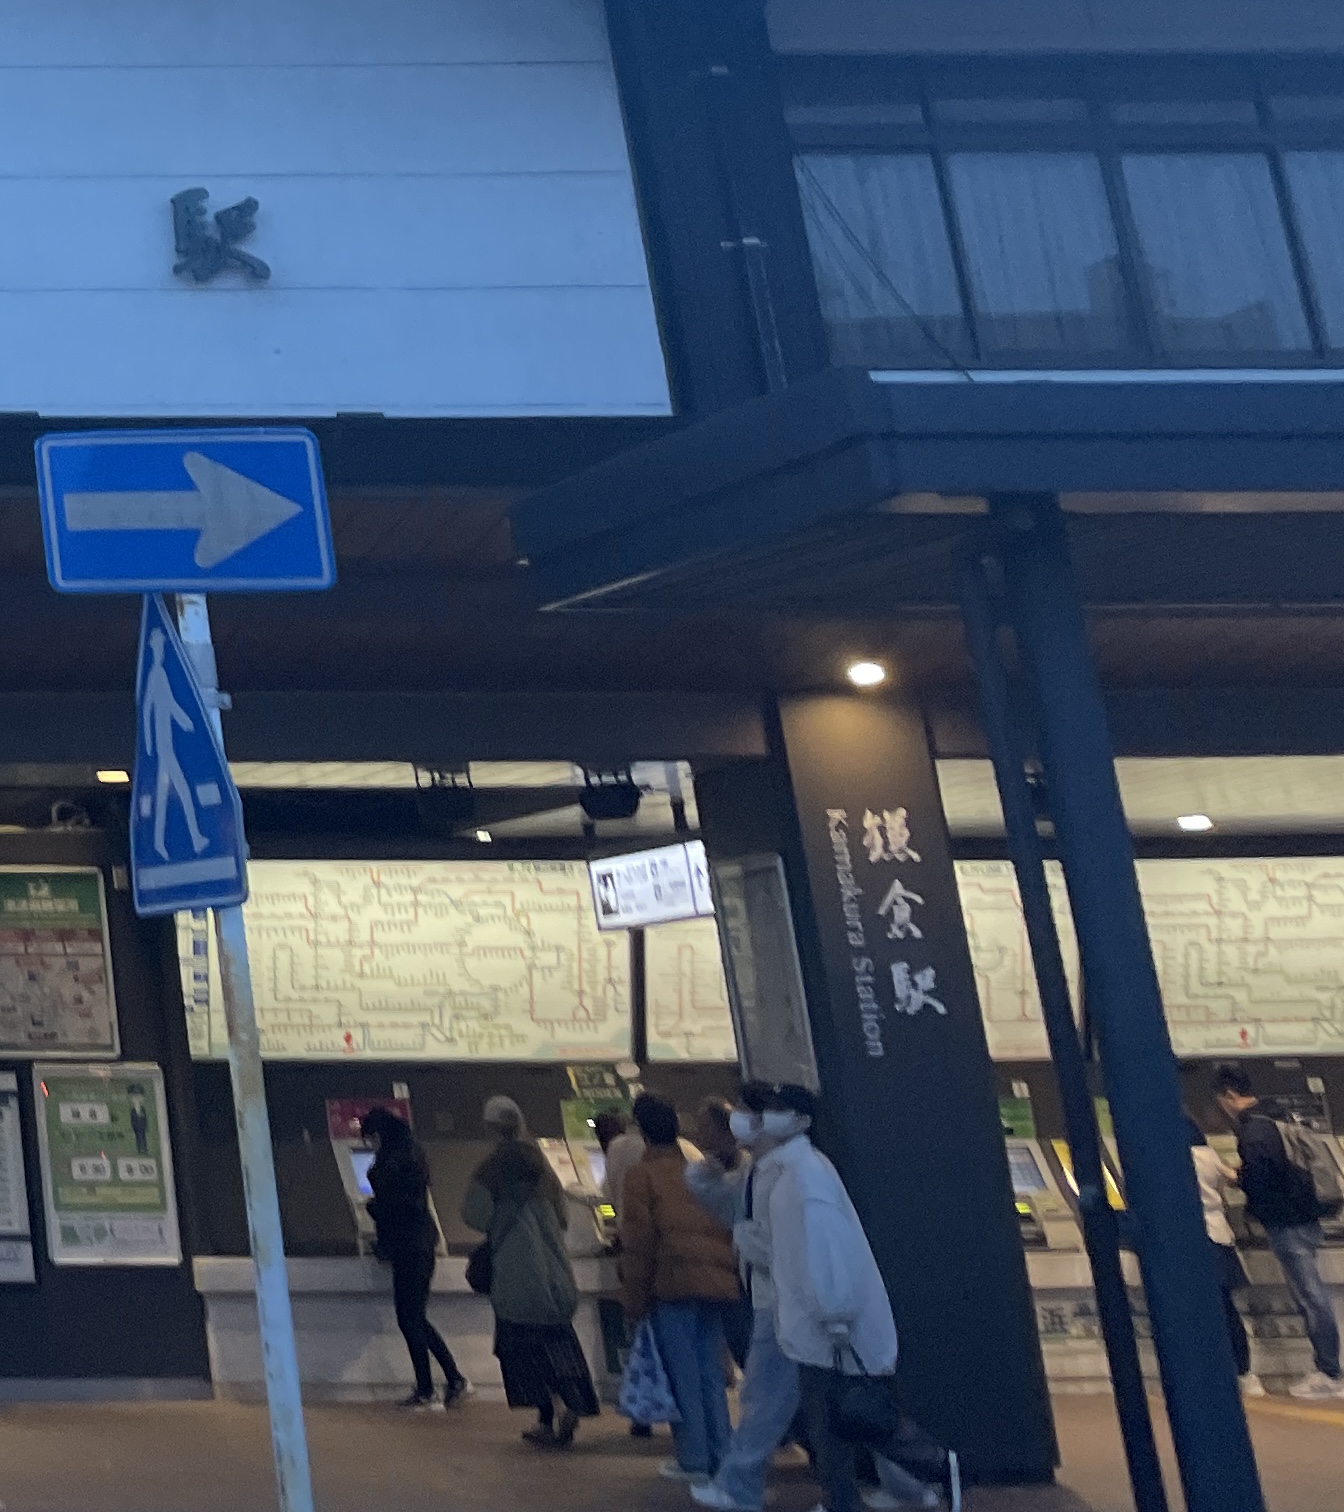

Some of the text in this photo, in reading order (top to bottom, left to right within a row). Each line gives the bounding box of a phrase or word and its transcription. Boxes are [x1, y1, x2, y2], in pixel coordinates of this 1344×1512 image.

[826, 808, 886, 1057] Kamakura Station
[862, 806, 948, 1016] 鎌倉駅
